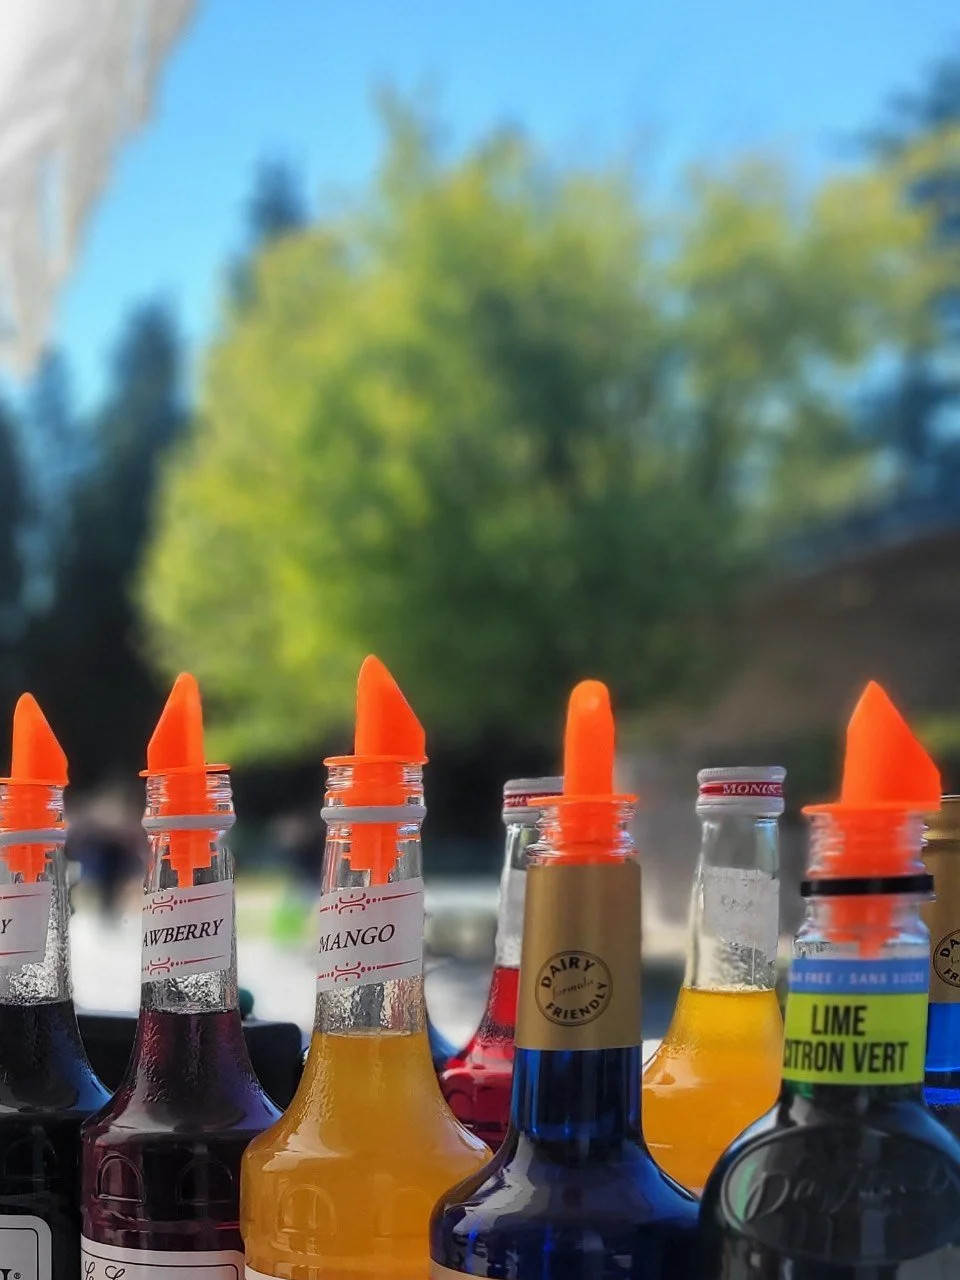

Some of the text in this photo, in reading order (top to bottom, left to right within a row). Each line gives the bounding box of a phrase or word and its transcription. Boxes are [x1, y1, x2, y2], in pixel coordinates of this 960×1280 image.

[319, 923, 395, 954] MANGO
[541, 956, 596, 989] DAIRY
[849, 971, 887, 985] SANS
[545, 982, 608, 1020] FRIENDLY
[811, 1004, 868, 1037] LIME
[783, 1037, 909, 1074] CITRON VERT
